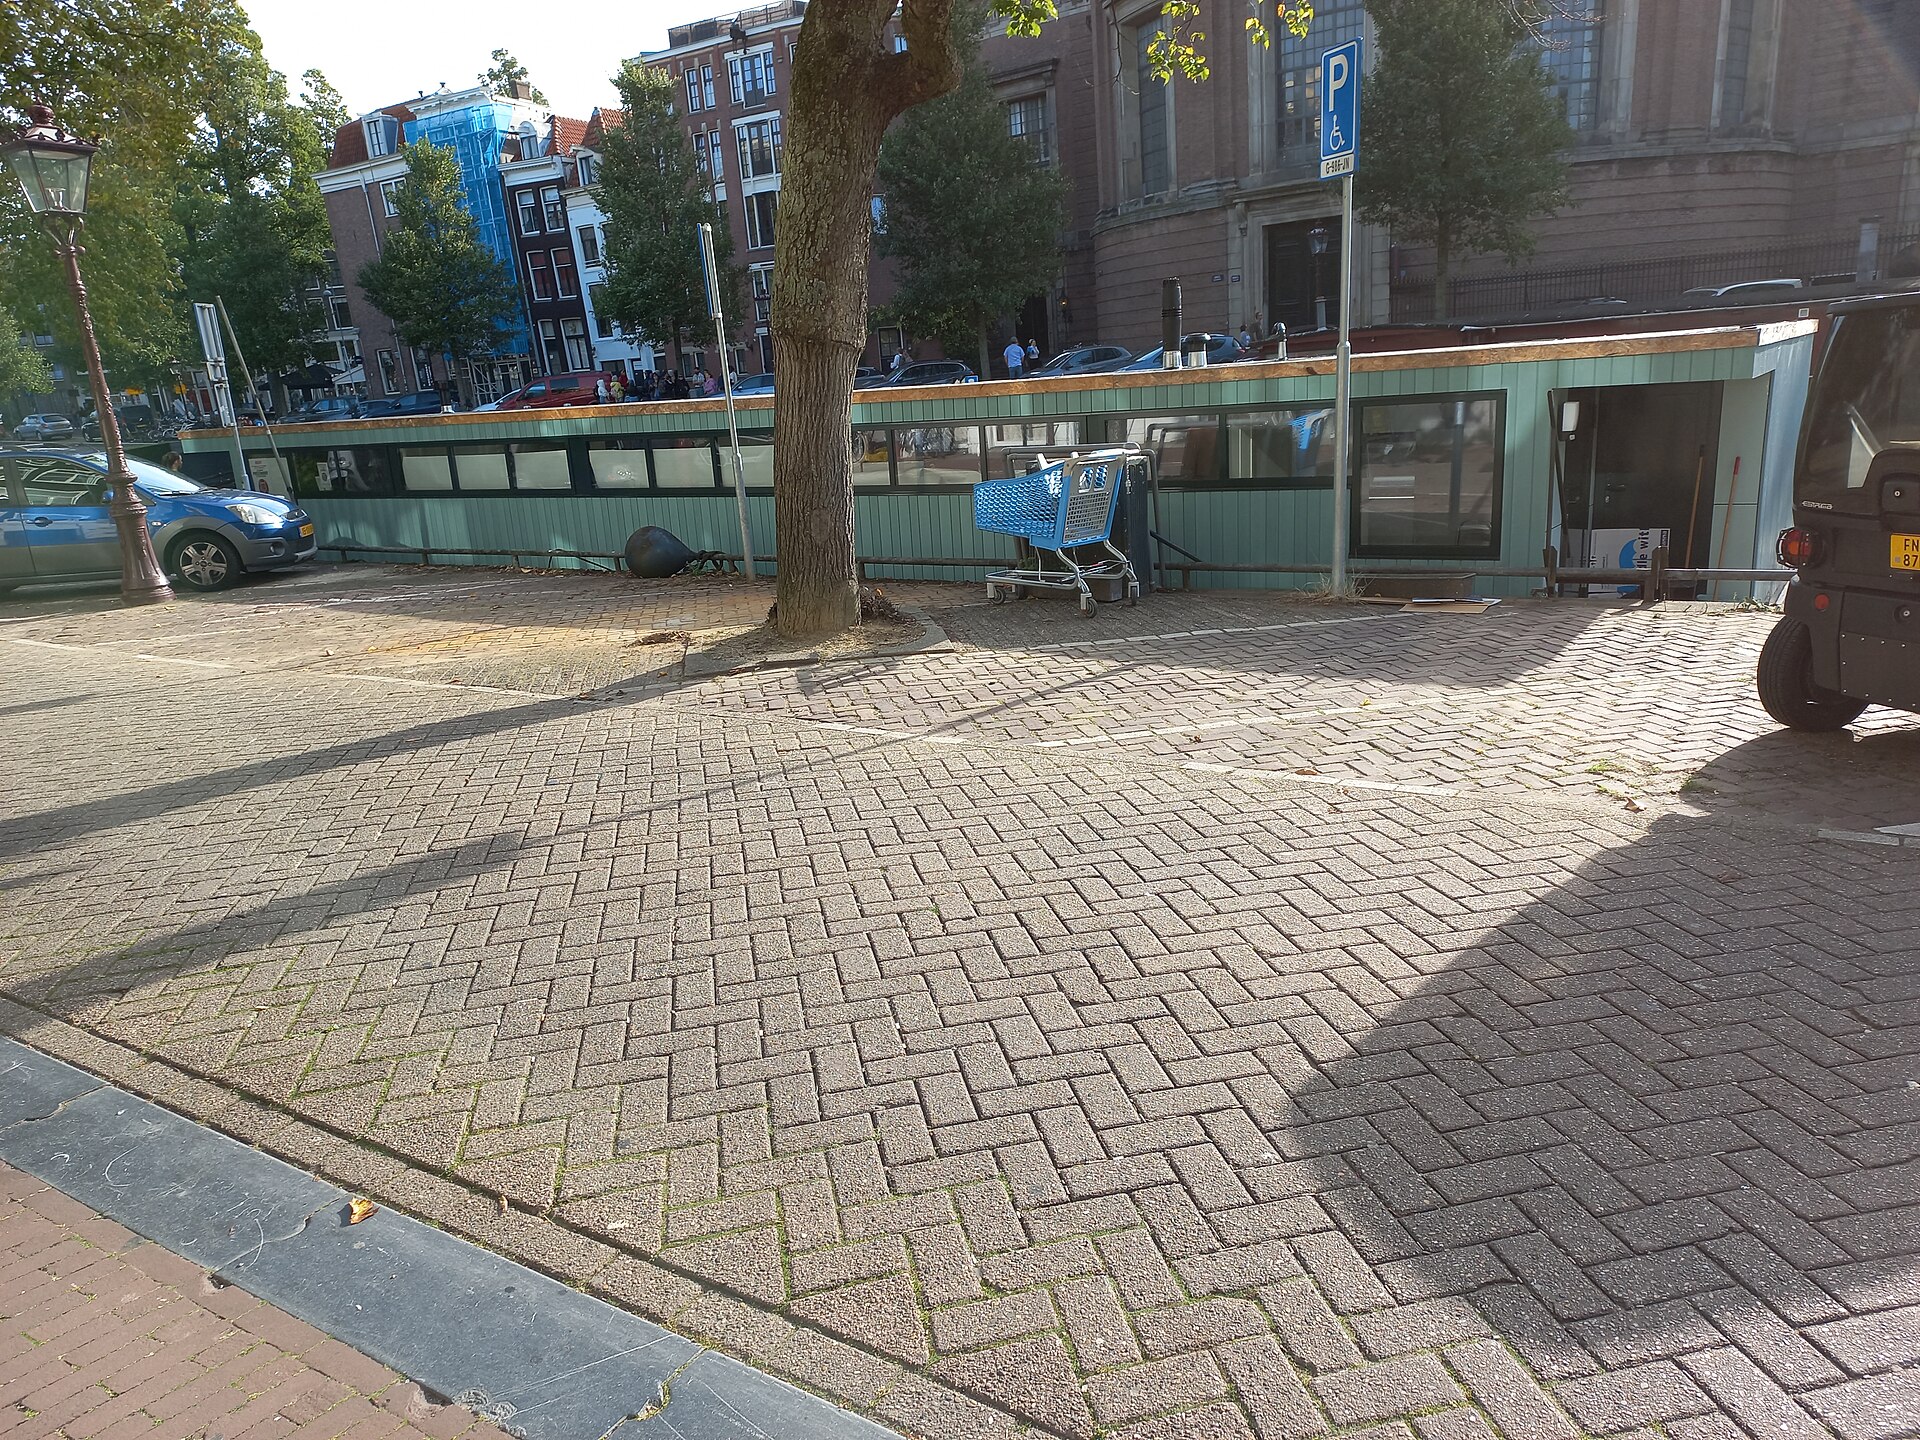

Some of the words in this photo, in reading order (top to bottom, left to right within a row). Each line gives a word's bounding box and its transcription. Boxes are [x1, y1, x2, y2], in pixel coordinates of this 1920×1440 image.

[1329, 54, 1348, 112] P
[1904, 538, 1919, 552] FN
[1903, 554, 1919, 567] 87
